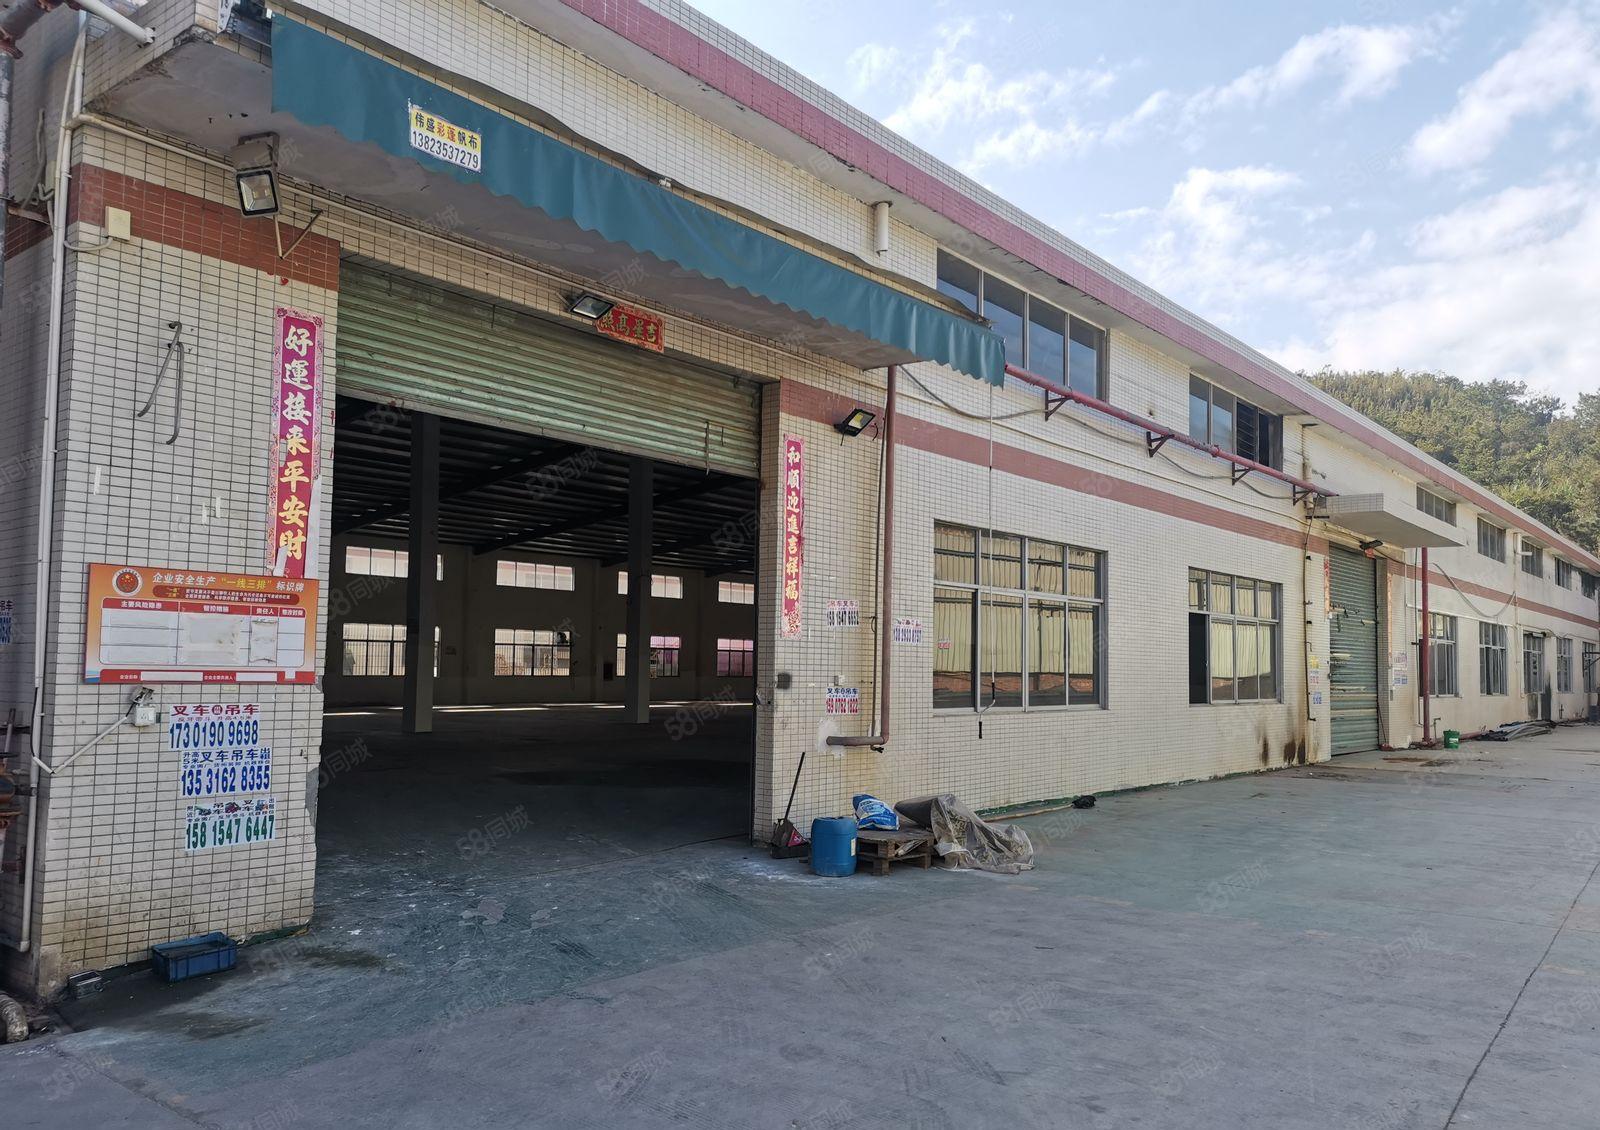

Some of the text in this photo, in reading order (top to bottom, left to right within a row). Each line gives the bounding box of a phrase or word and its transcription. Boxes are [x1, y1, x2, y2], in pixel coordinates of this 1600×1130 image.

[413, 131, 478, 168] 13823537279
[152, 572, 216, 586] 企业安全生产
[276, 580, 304, 592] 标识牌
[228, 720, 259, 746] 9698
[182, 765, 270, 796] 135 3162 8355
[186, 815, 275, 850] 158 1547 6447
